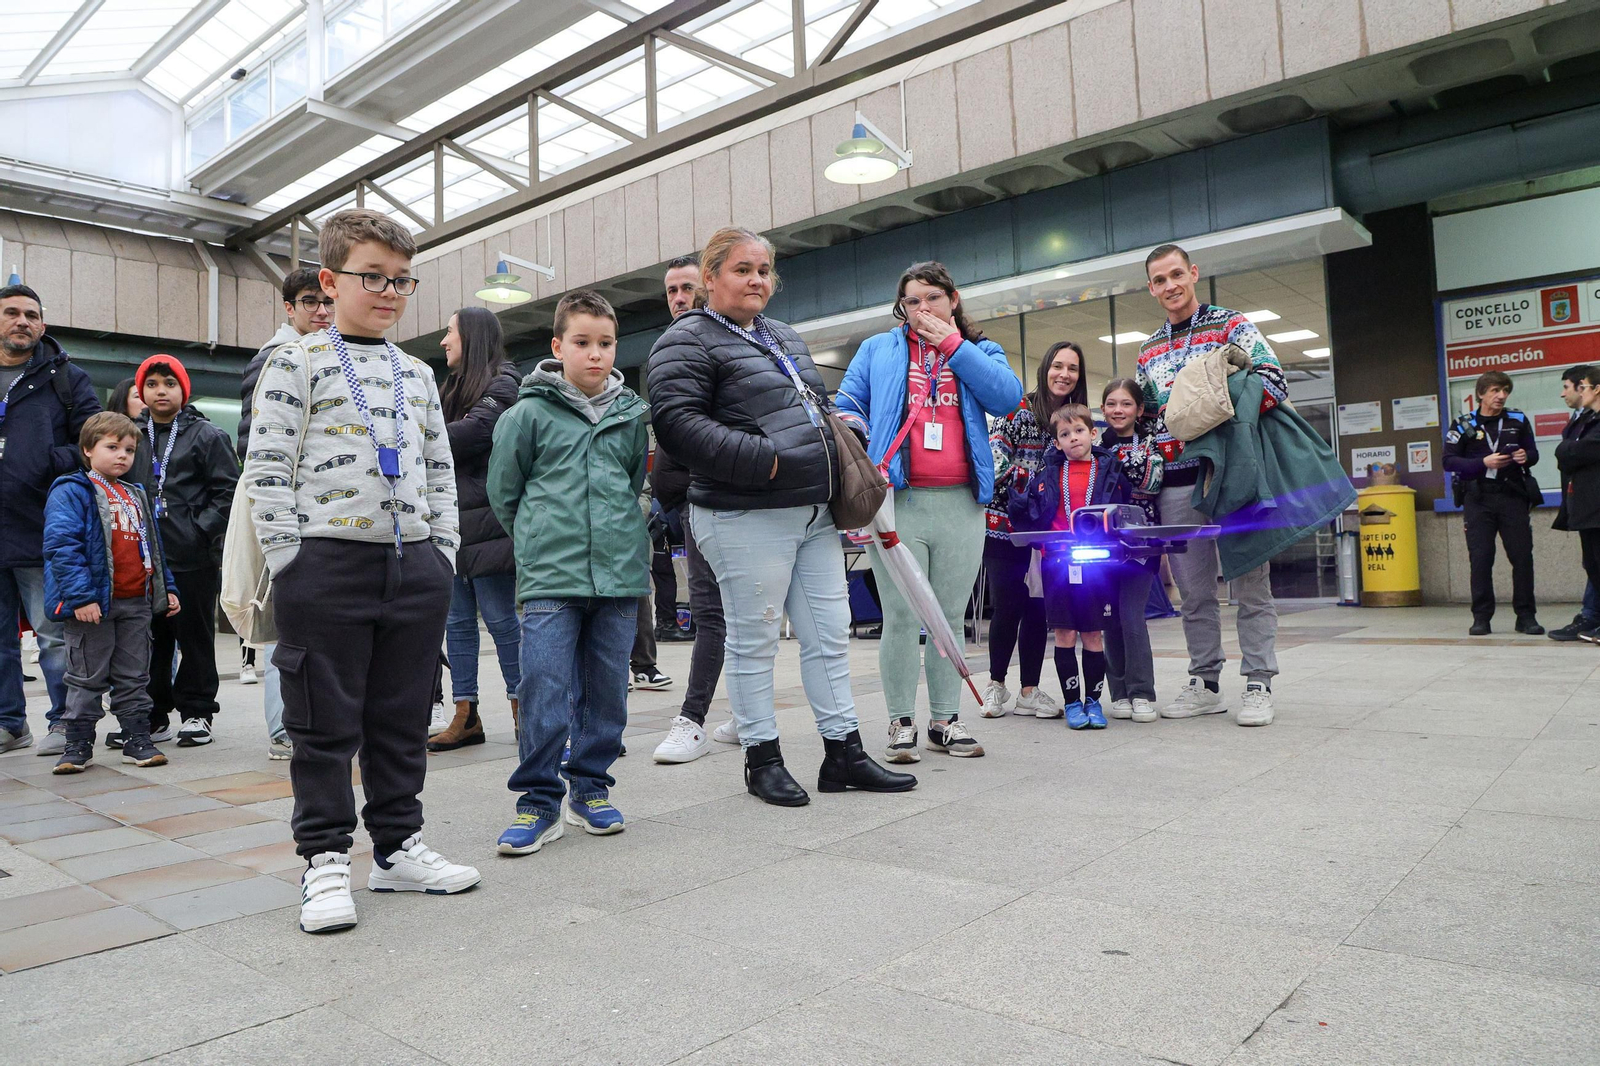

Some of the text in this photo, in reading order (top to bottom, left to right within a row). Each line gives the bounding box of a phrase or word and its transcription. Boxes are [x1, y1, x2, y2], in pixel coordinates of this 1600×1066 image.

[1456, 300, 1530, 319] CONCELLO
[1465, 314, 1522, 330] DE VIGO
[1449, 348, 1544, 370] Información
[1356, 451, 1391, 459] HORARIO
[1368, 563, 1386, 571] REAL
